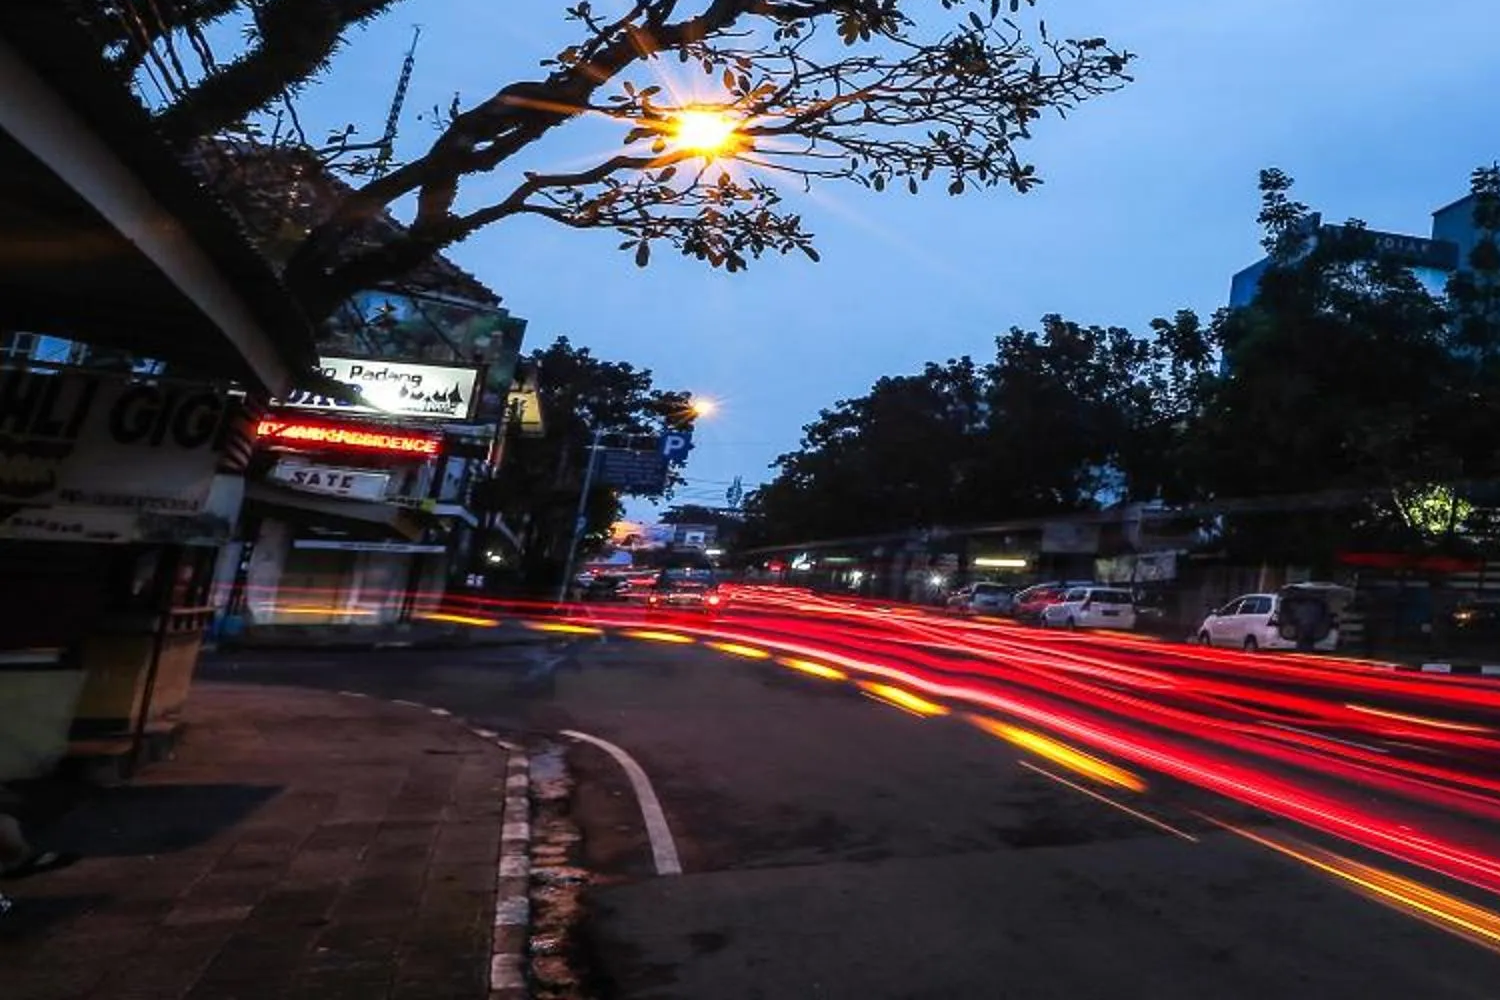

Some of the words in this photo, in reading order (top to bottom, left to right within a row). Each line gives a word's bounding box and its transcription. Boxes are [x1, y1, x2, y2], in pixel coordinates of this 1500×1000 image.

[349, 365, 423, 388] Padang
[663, 434, 686, 456] P
[289, 471, 354, 489] SATE
